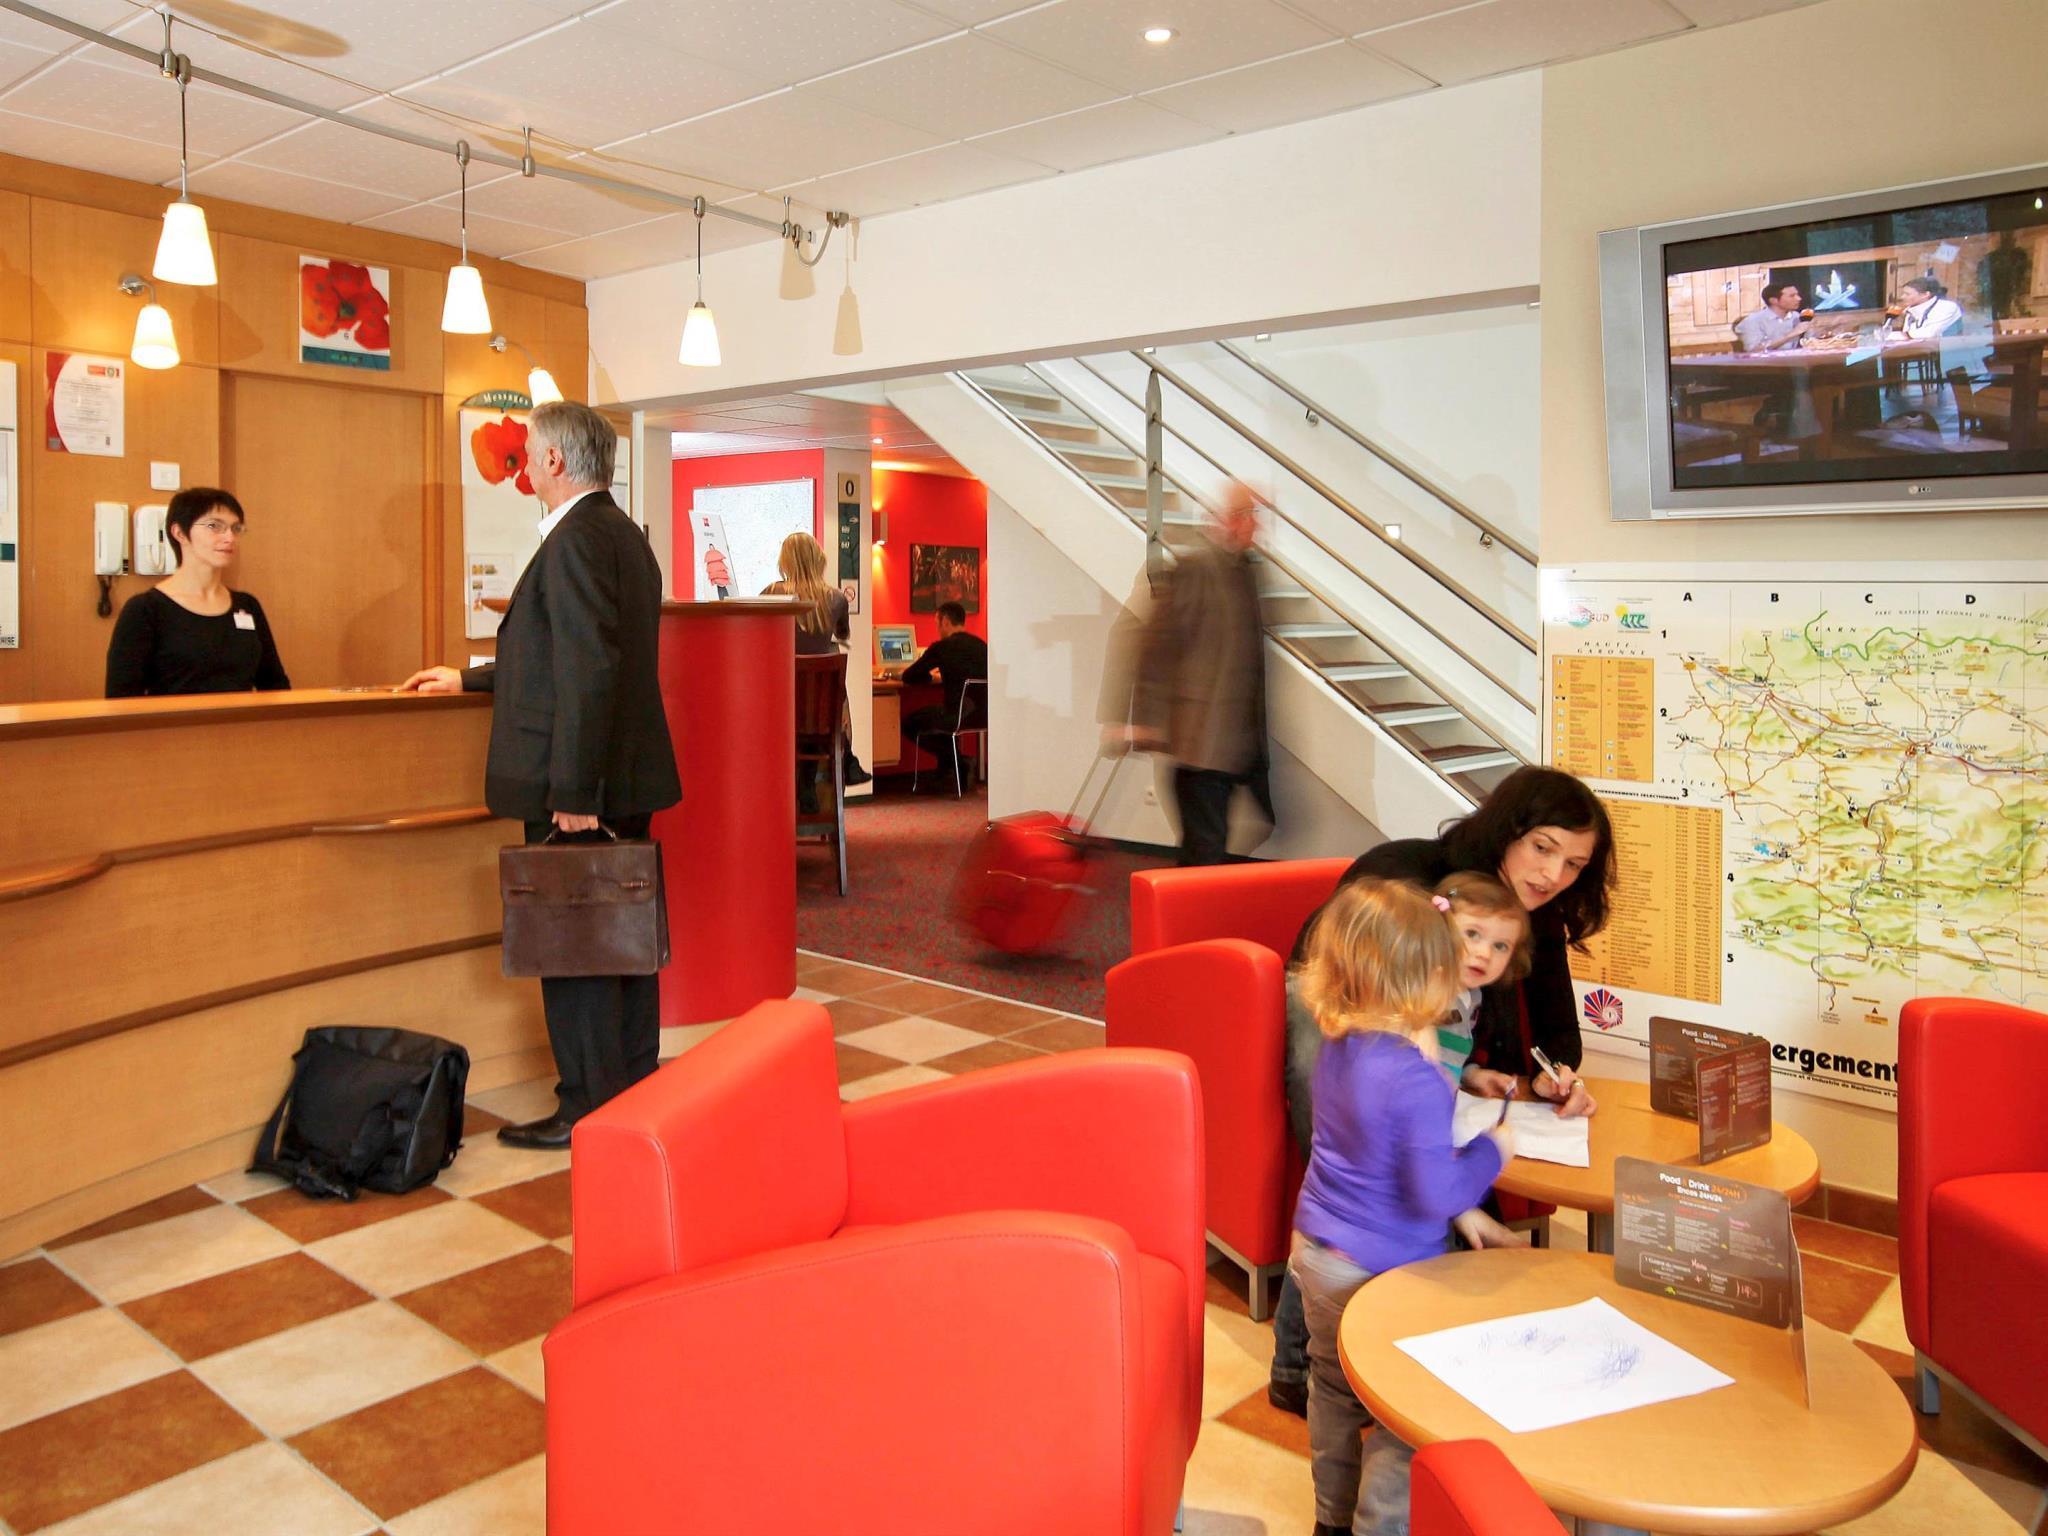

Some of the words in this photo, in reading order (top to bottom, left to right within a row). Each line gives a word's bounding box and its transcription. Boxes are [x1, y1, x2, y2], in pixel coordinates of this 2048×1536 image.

[845, 480, 854, 497] 0
[1683, 592, 1692, 602] A
[1771, 592, 1779, 602] B
[1864, 593, 1874, 604] C
[1965, 594, 1976, 605] D
[1661, 629, 1667, 639] 1
[1660, 708, 1668, 718] 2
[1681, 788, 1689, 798] 3
[1727, 873, 1735, 882] 4
[1727, 953, 1735, 963] 5
[1659, 1172, 1681, 1186] Food
[1688, 1179, 1710, 1192] Drink
